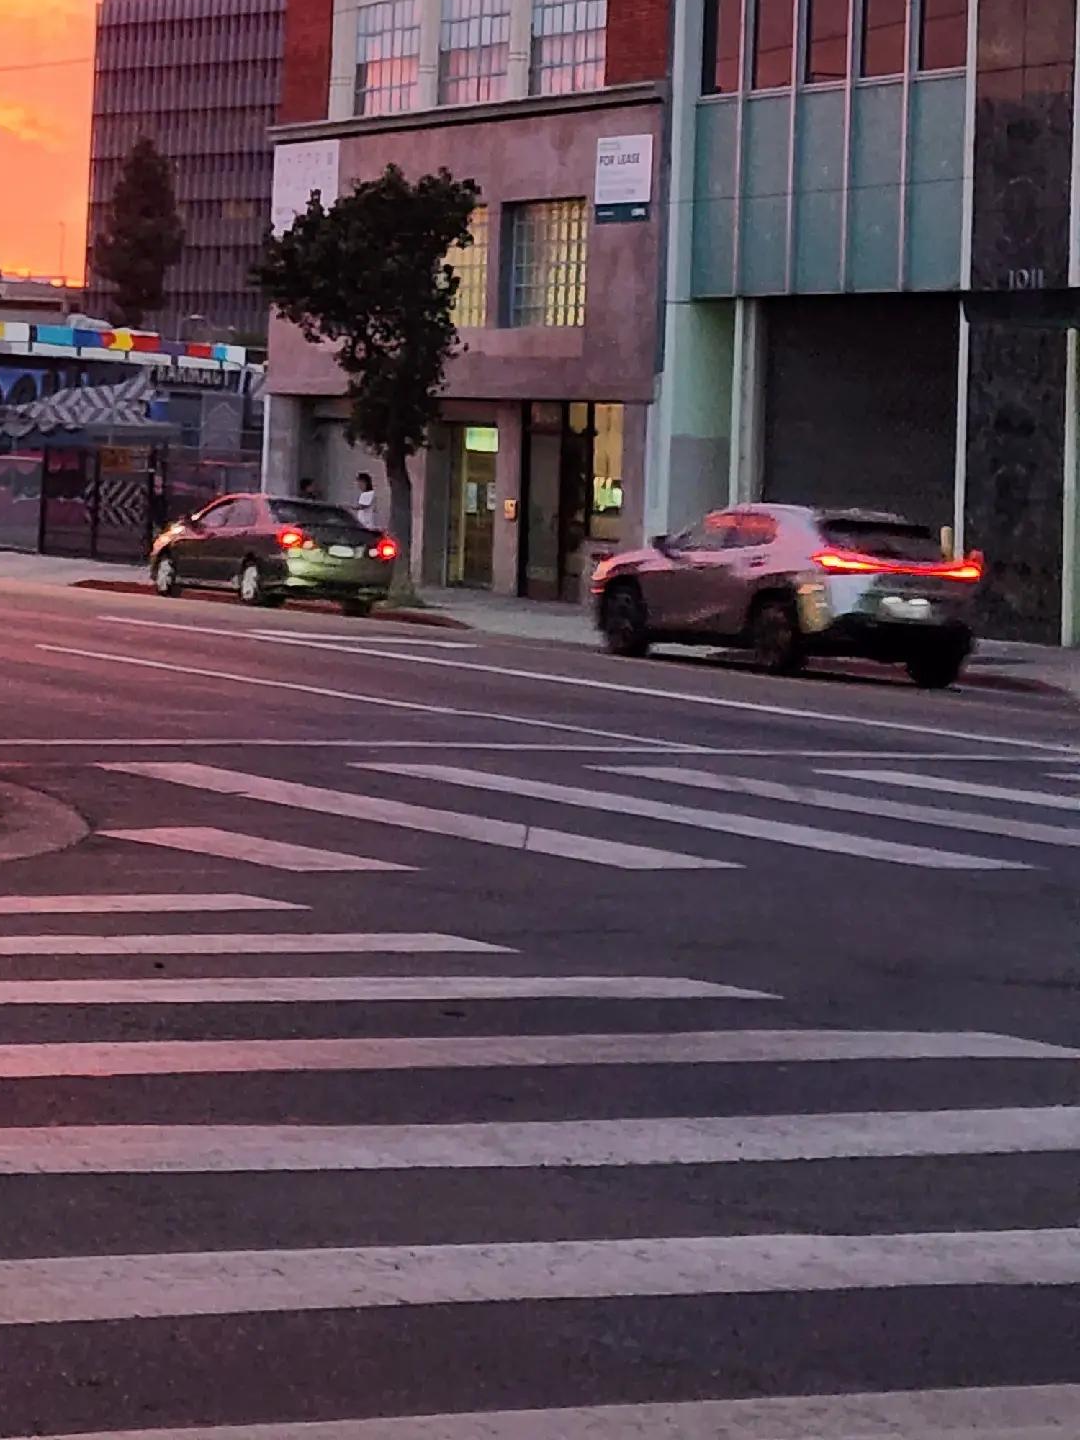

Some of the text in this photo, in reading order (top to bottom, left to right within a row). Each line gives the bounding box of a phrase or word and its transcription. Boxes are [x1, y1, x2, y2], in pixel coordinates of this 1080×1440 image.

[599, 153, 640, 166] FOR LEASE
[1008, 268, 1044, 290] 1011
